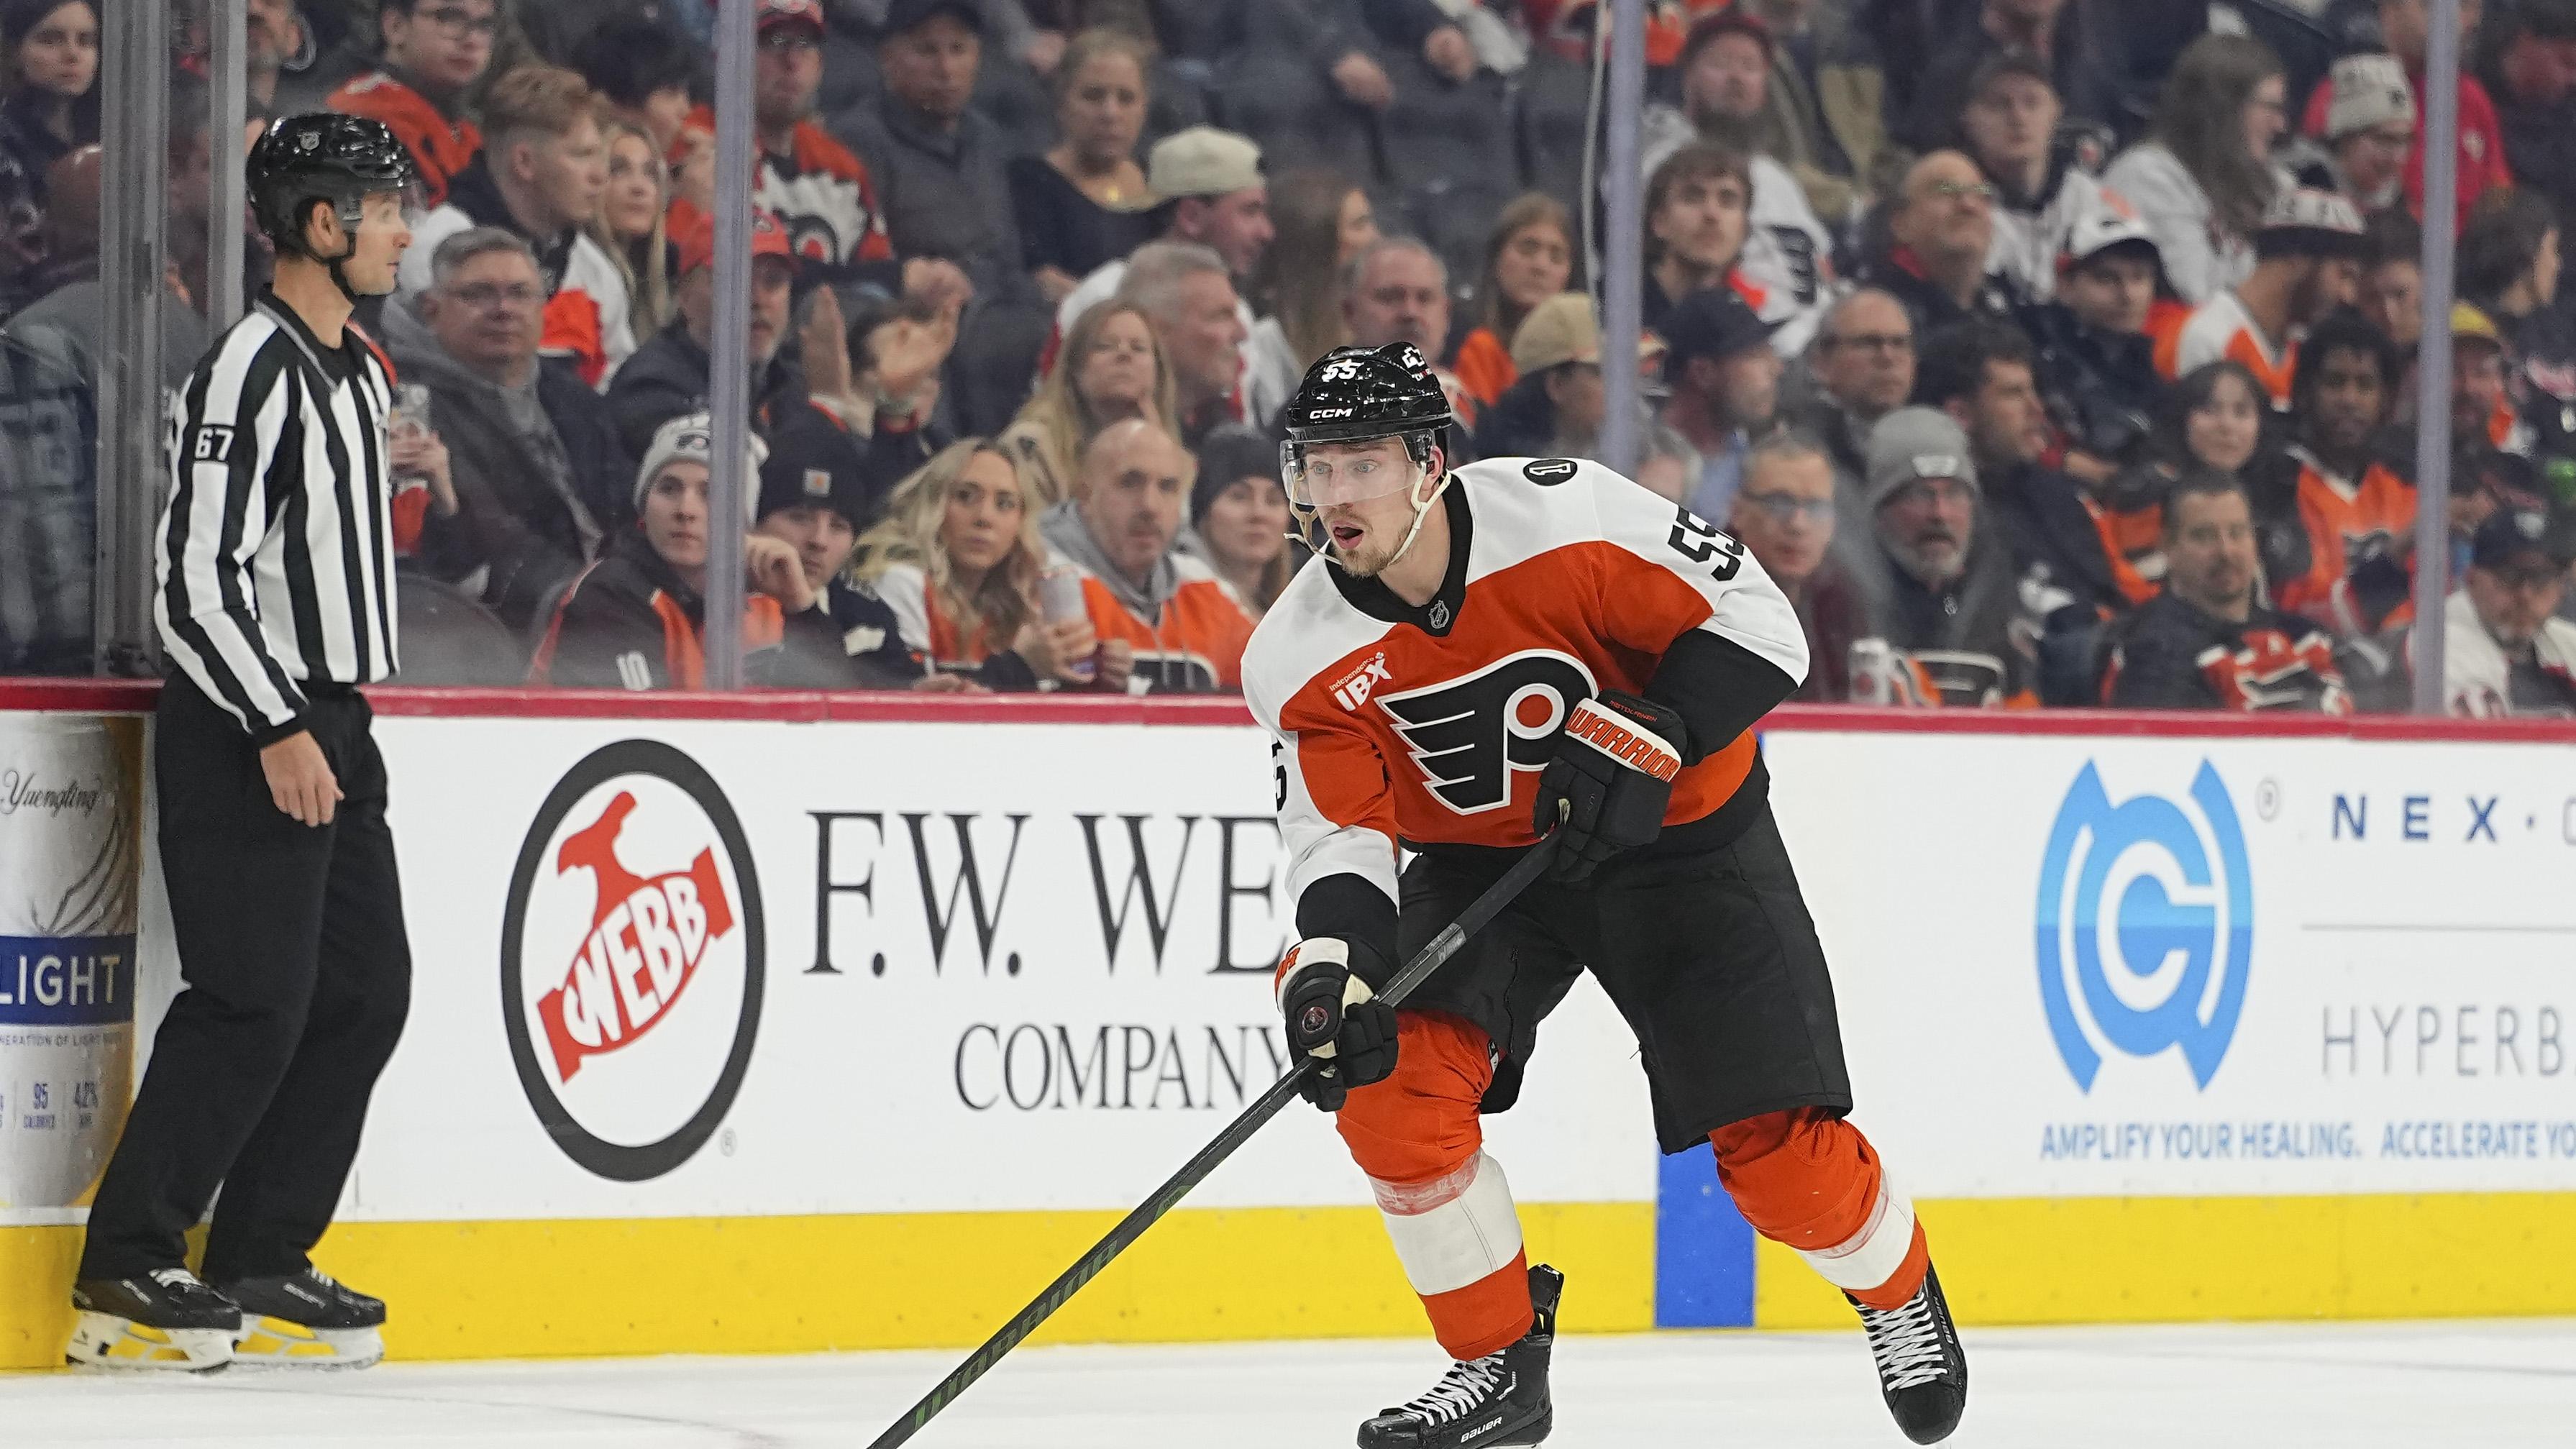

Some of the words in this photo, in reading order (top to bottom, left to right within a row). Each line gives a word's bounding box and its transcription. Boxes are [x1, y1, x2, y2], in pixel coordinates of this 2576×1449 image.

[1321, 359, 1365, 383] 55
[1310, 408, 1353, 420] CCM
[195, 426, 234, 461] 67
[1668, 505, 1745, 582] 55
[1328, 657, 1375, 692] Independence
[1334, 657, 1393, 711] IBX
[1565, 707, 1680, 783] WARRIOR
[0, 770, 103, 819] Yuengling
[562, 874, 708, 1048] WEBB
[2321, 1005, 2576, 1077] HYPERB
[954, 1023, 1289, 1110] COMPANY
[2040, 1123, 2155, 1161] AMPLIFY
[2160, 1123, 2234, 1161] YOUR
[2239, 1123, 2362, 1161] HEALING.
[2380, 1123, 2537, 1159] ACCELERATE
[1461, 1417, 1502, 1443] BAUER
